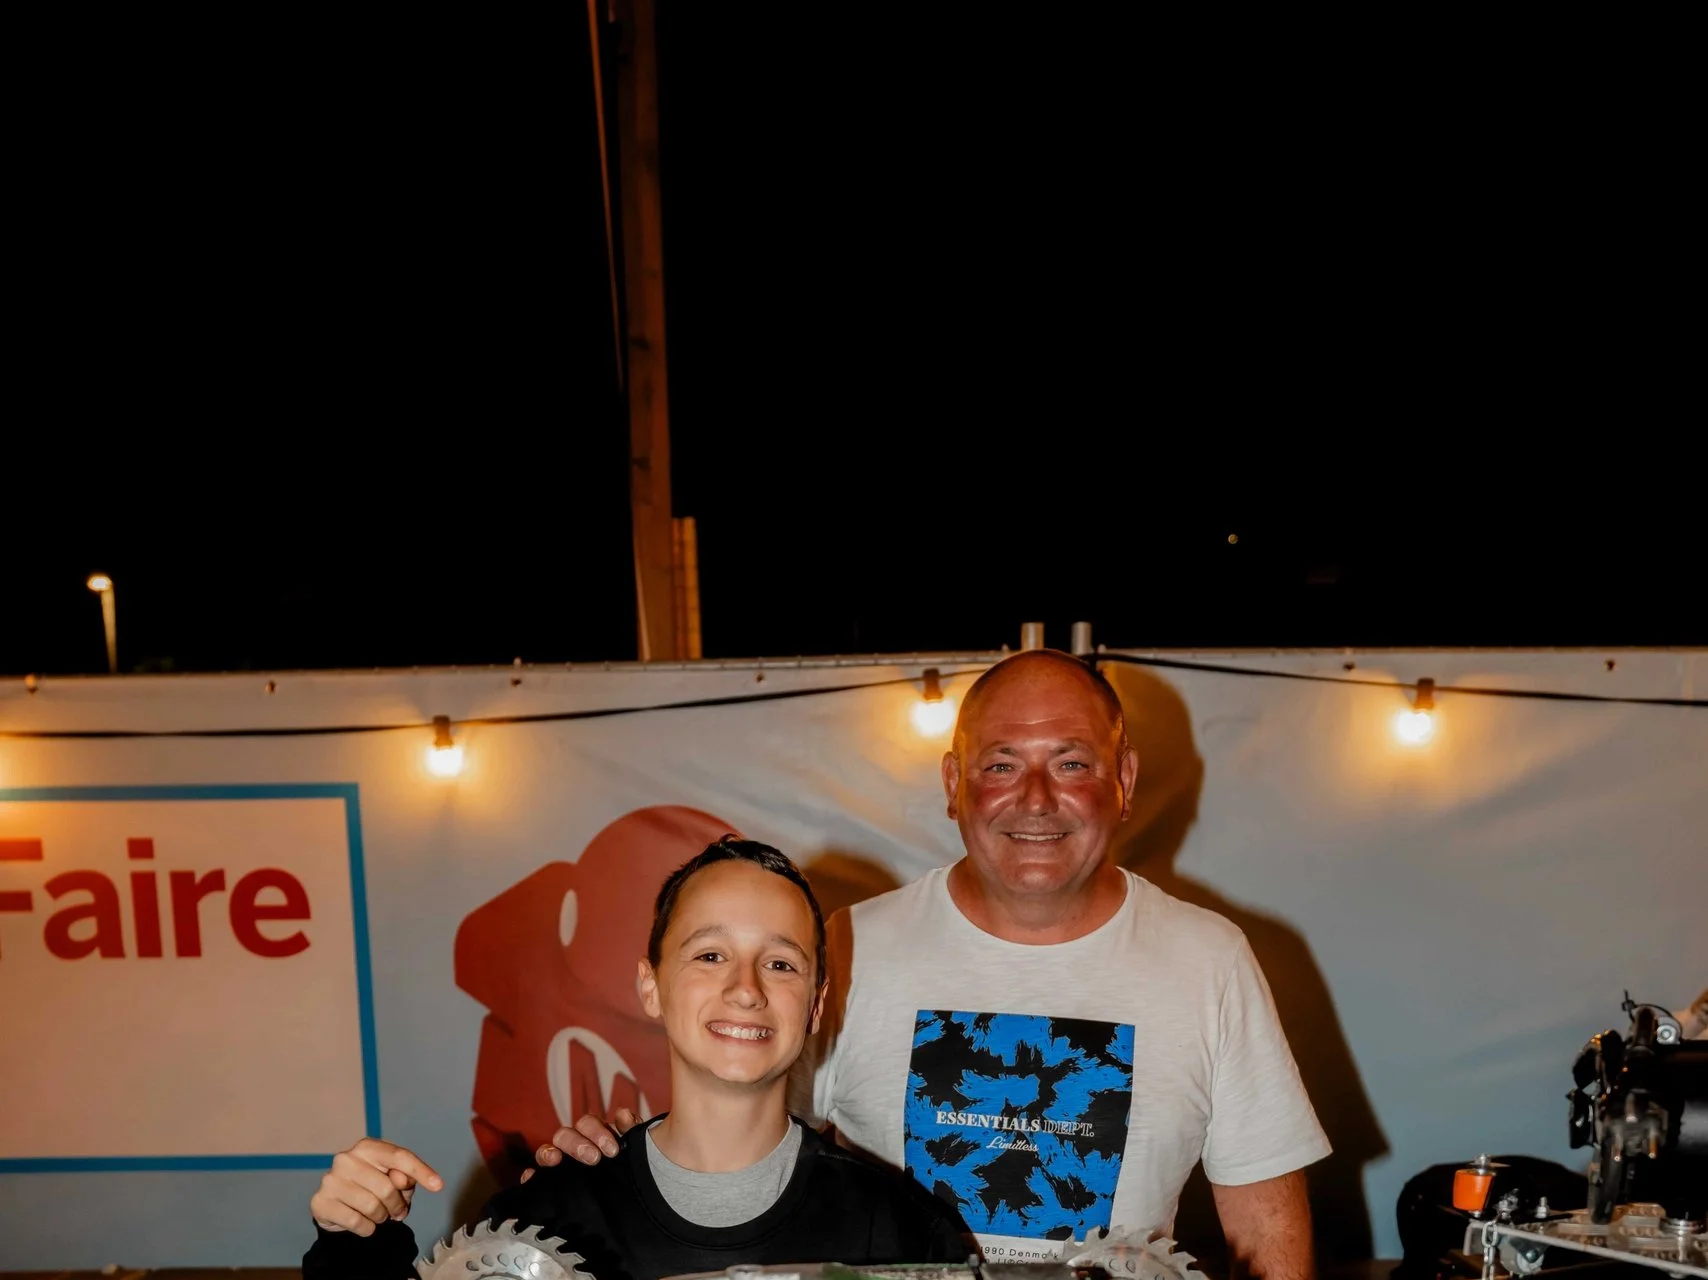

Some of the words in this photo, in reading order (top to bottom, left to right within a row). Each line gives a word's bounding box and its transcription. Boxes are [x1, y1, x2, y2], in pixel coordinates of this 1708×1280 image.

[935, 1110, 1041, 1132] ESSENTIALS
[986, 1136, 1039, 1152] Limitless
[1009, 1248, 1059, 1260] Denmak
